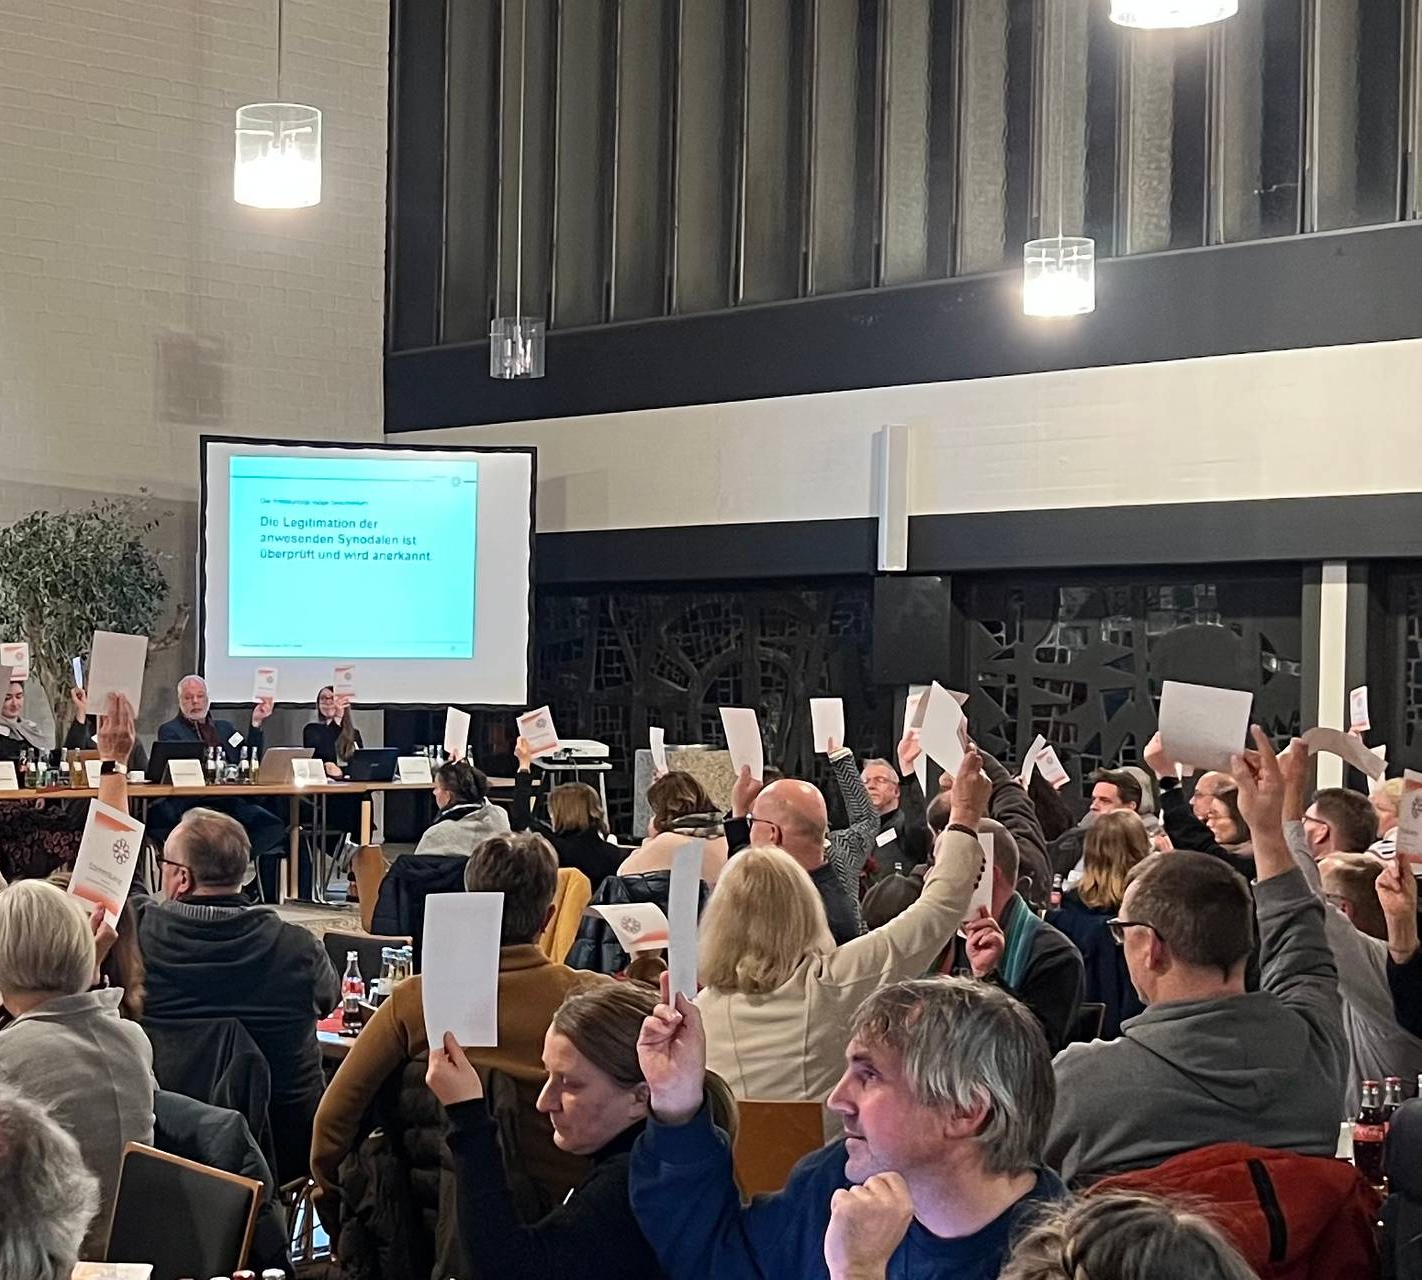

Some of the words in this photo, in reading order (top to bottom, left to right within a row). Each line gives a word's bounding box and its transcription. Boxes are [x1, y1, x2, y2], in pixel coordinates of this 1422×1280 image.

[260, 516, 279, 527] Die
[283, 517, 356, 530] Legitimation
[359, 518, 378, 529] der
[260, 534, 334, 544] anwesenden
[337, 534, 399, 547] Synodalen
[402, 535, 417, 545] ist
[260, 549, 315, 560] überprüft
[318, 550, 340, 560] und
[344, 551, 369, 561] wird
